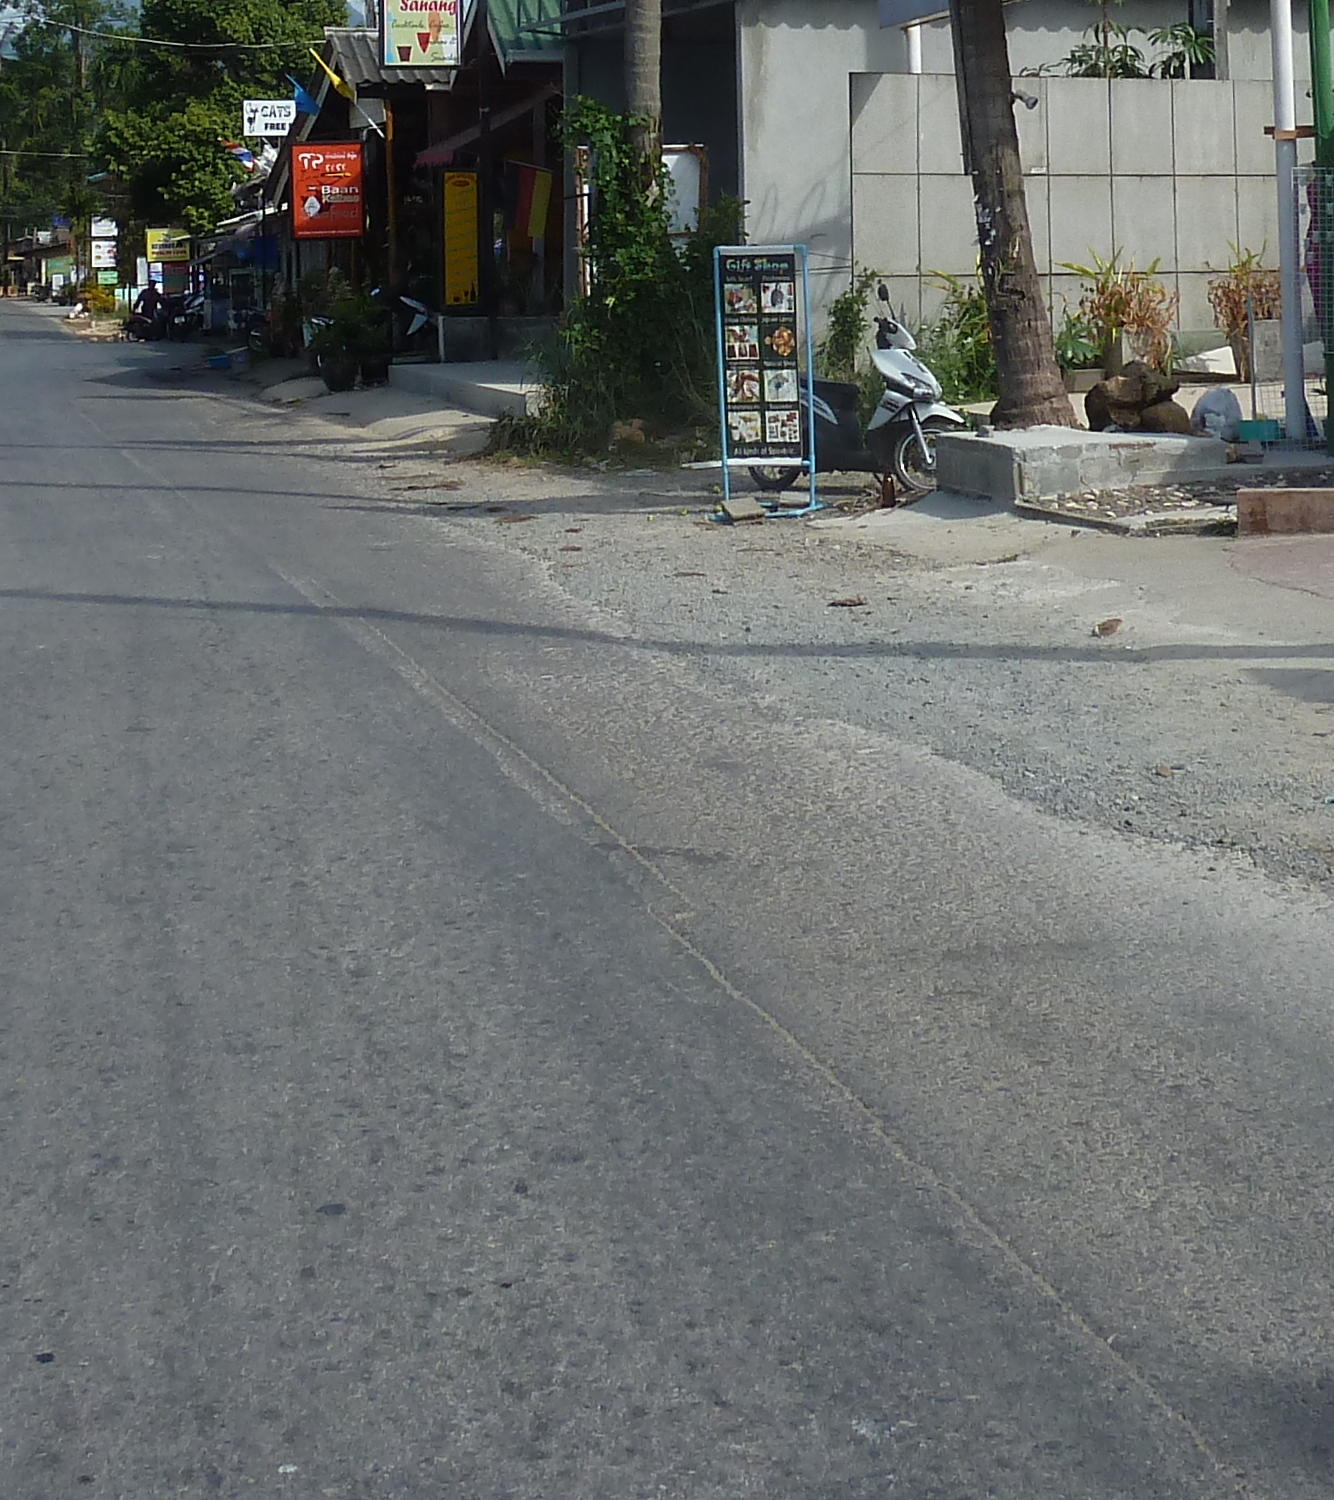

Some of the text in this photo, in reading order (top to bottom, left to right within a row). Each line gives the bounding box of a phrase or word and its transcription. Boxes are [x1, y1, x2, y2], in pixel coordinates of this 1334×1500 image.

[260, 105, 292, 118] CATS
[321, 185, 359, 195] Baan
[726, 258, 789, 274] Gift Shop
